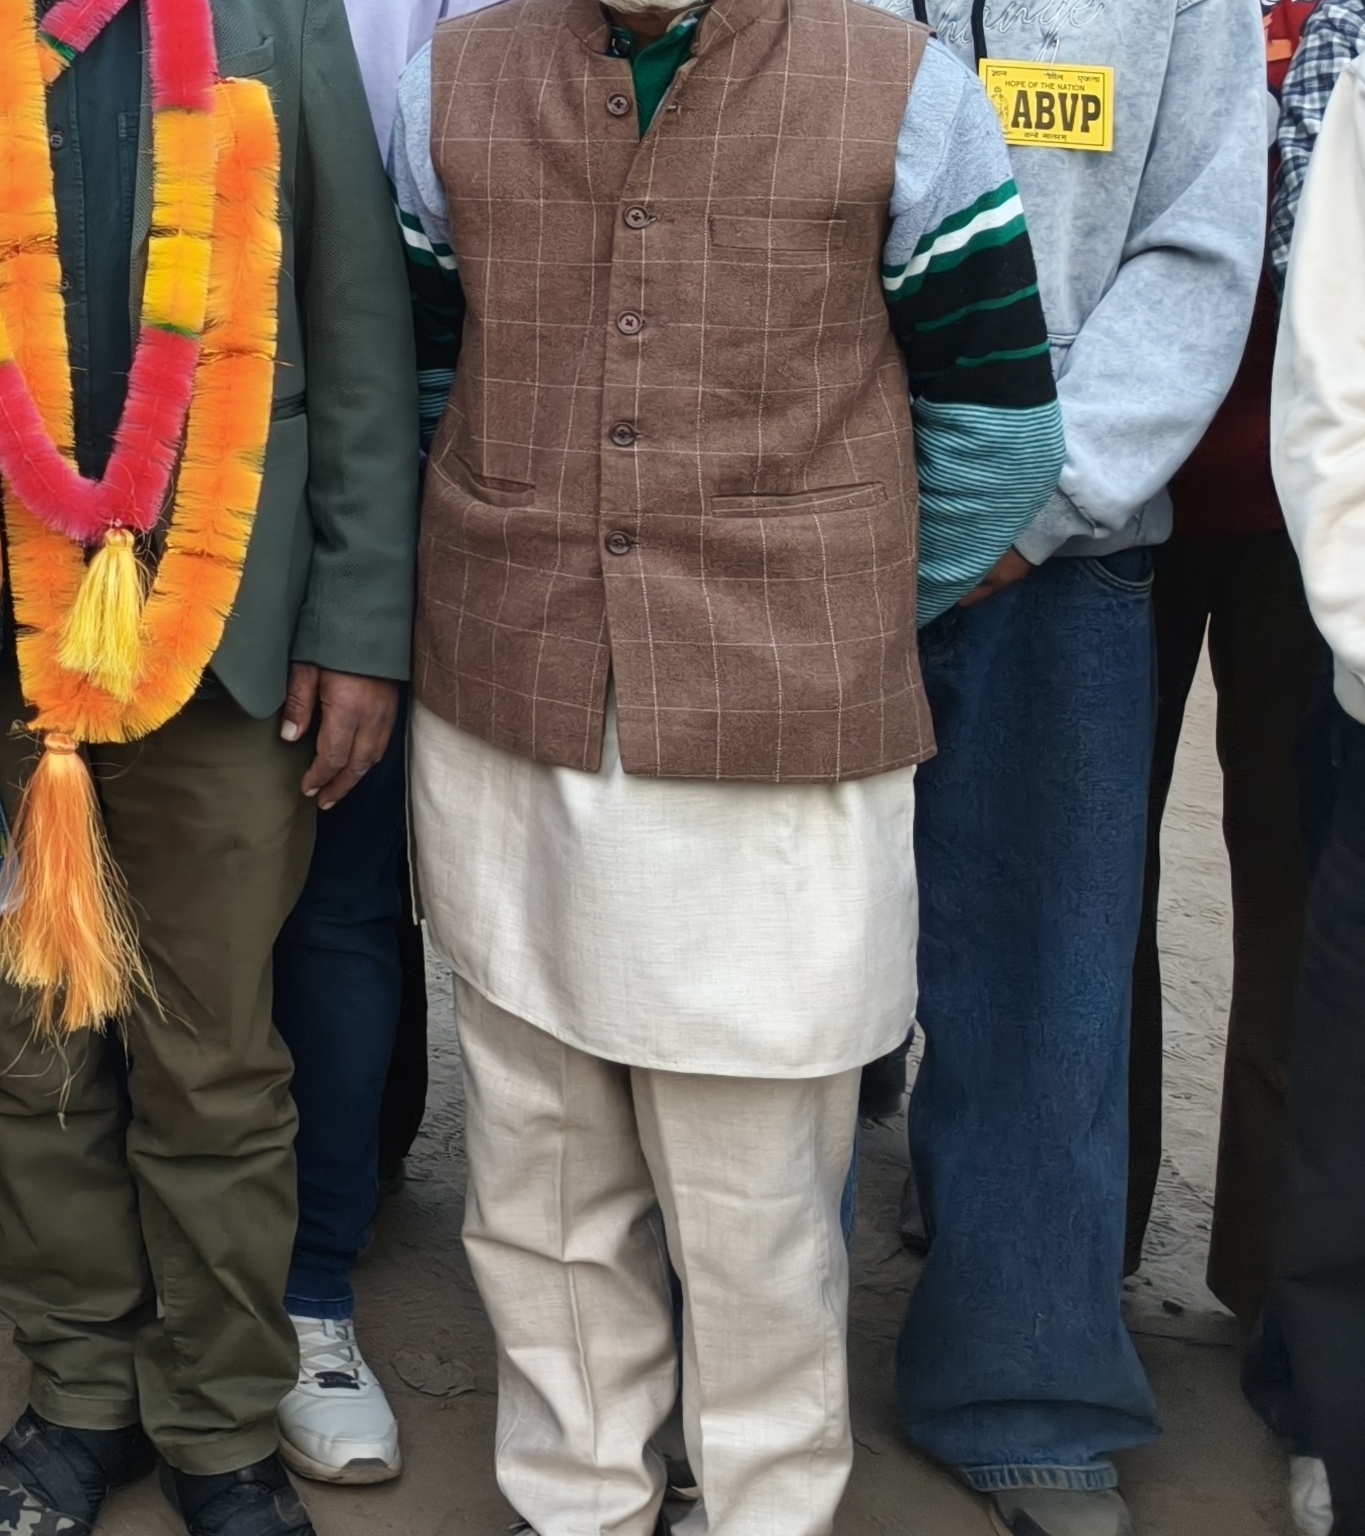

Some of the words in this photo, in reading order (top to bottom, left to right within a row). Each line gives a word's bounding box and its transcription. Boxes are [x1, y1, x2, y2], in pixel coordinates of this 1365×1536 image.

[1005, 80, 1026, 88] HOPE
[1041, 82, 1055, 90] THE
[1057, 83, 1085, 92] NATION
[1010, 89, 1101, 133] ABVP
